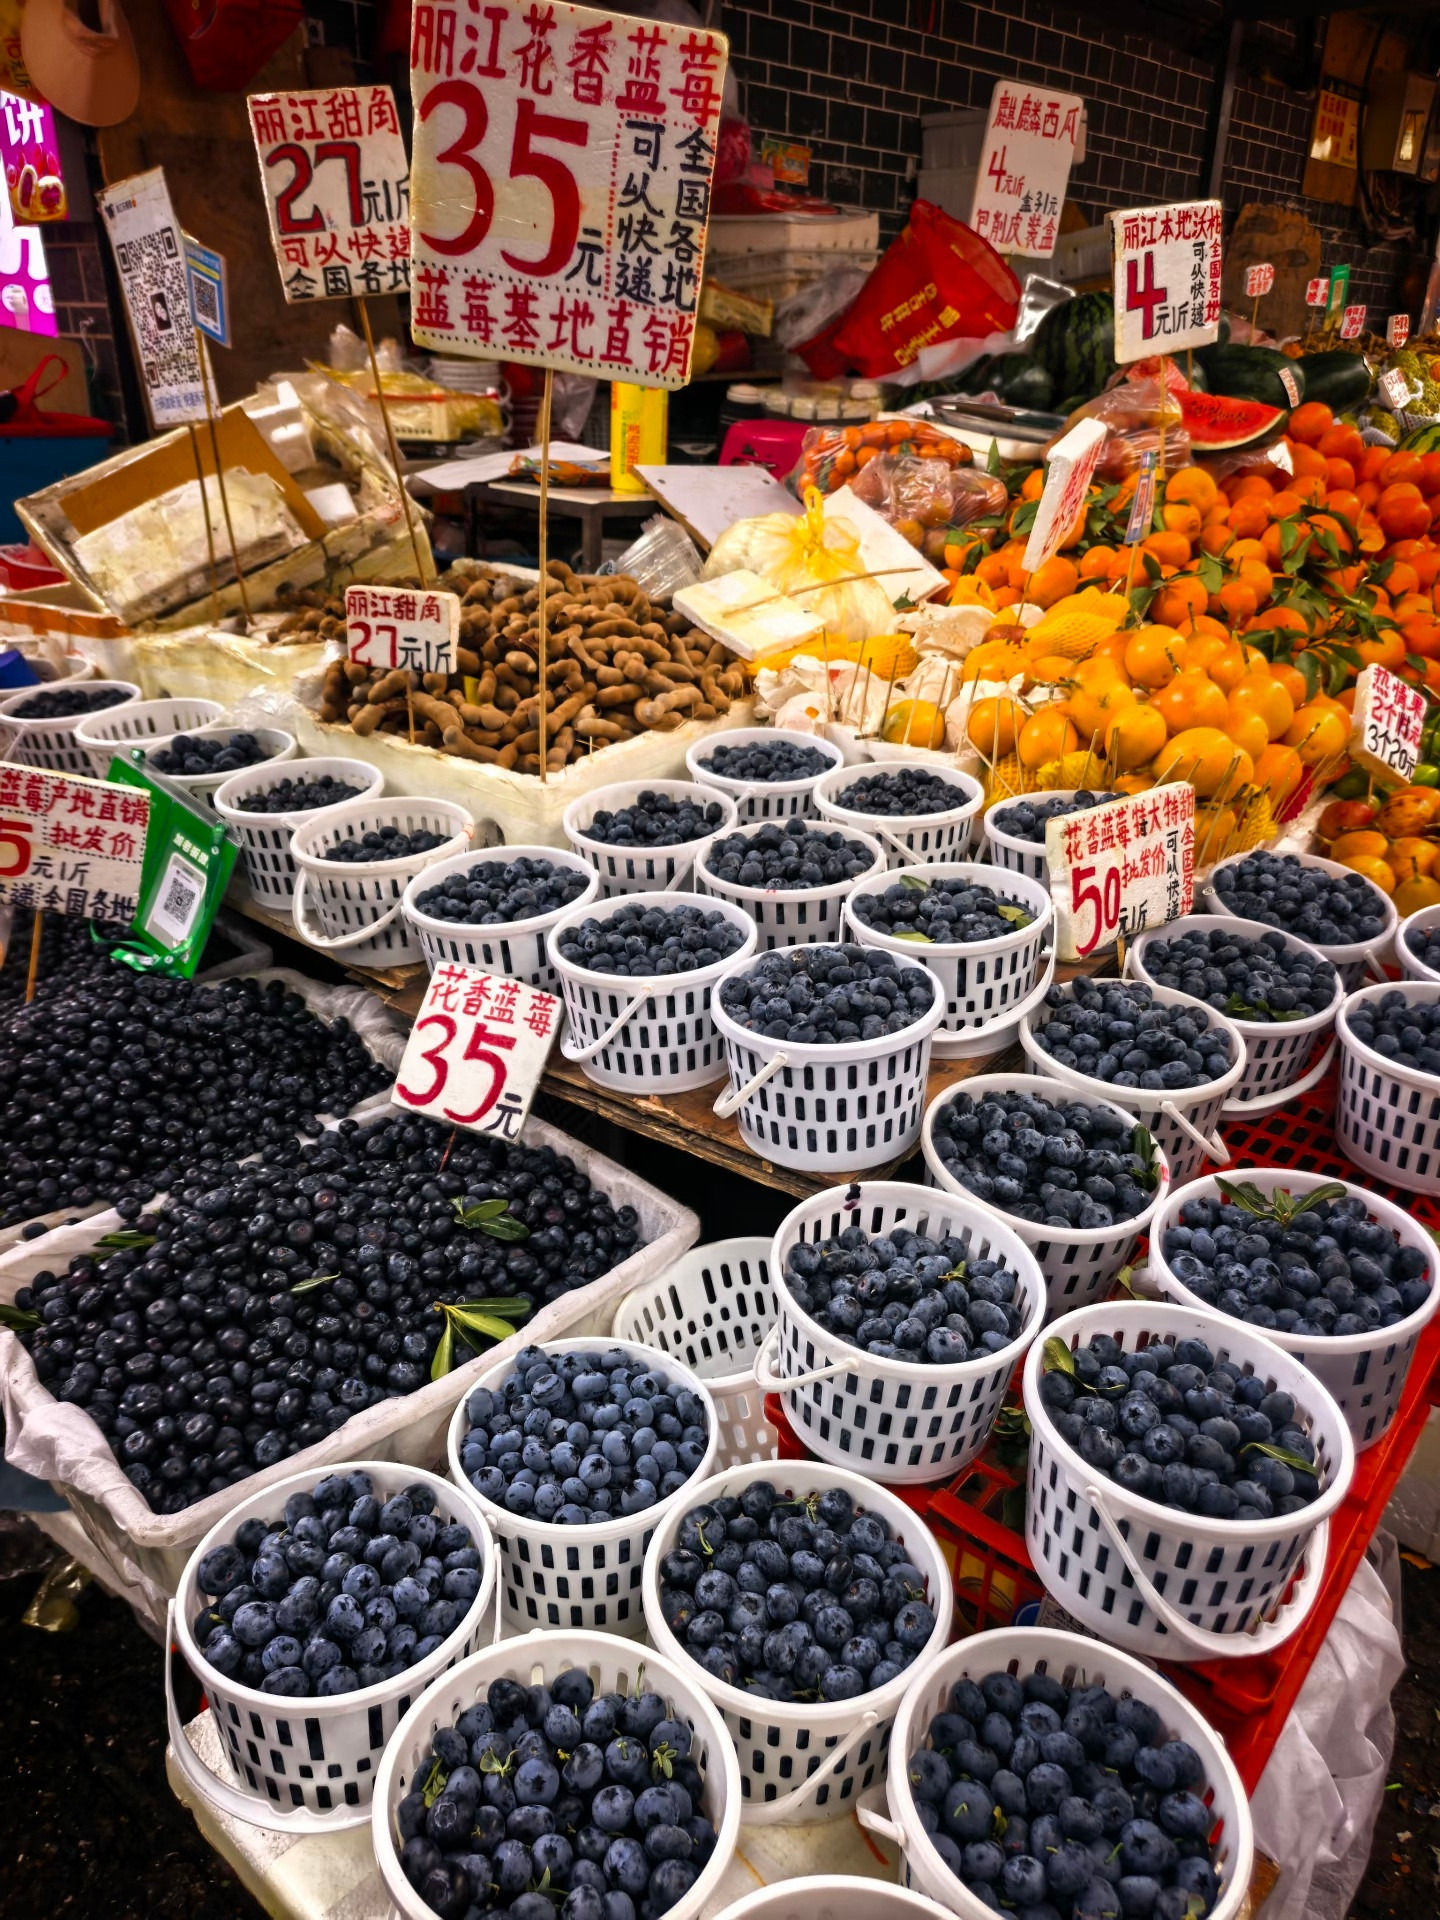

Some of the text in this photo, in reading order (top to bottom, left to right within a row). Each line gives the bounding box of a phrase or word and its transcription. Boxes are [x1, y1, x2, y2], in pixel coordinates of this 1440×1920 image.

[410, 0, 722, 126] 丽江花香蓝莓
[251, 87, 399, 144] 丽江甜角
[992, 90, 1080, 144] 麒麟西瓜
[418, 79, 606, 287] 35元
[280, 225, 410, 269] 可以快递
[658, 126, 716, 313] 全国各地
[1205, 239, 1222, 323] 全国各地
[414, 267, 693, 377] 蓝莓基地直销
[346, 591, 441, 624] 丽江甜角
[1372, 666, 1423, 720] 热情果
[1367, 724, 1416, 780] 3个20元
[0, 771, 149, 828] 蓝莓产地直销
[49, 821, 136, 858] 批发价
[1122, 842, 1166, 888] 批发价
[1179, 822, 1195, 915] 全国各地
[429, 964, 556, 1038] 花香蓝莓
[396, 1014, 523, 1139] 35元
